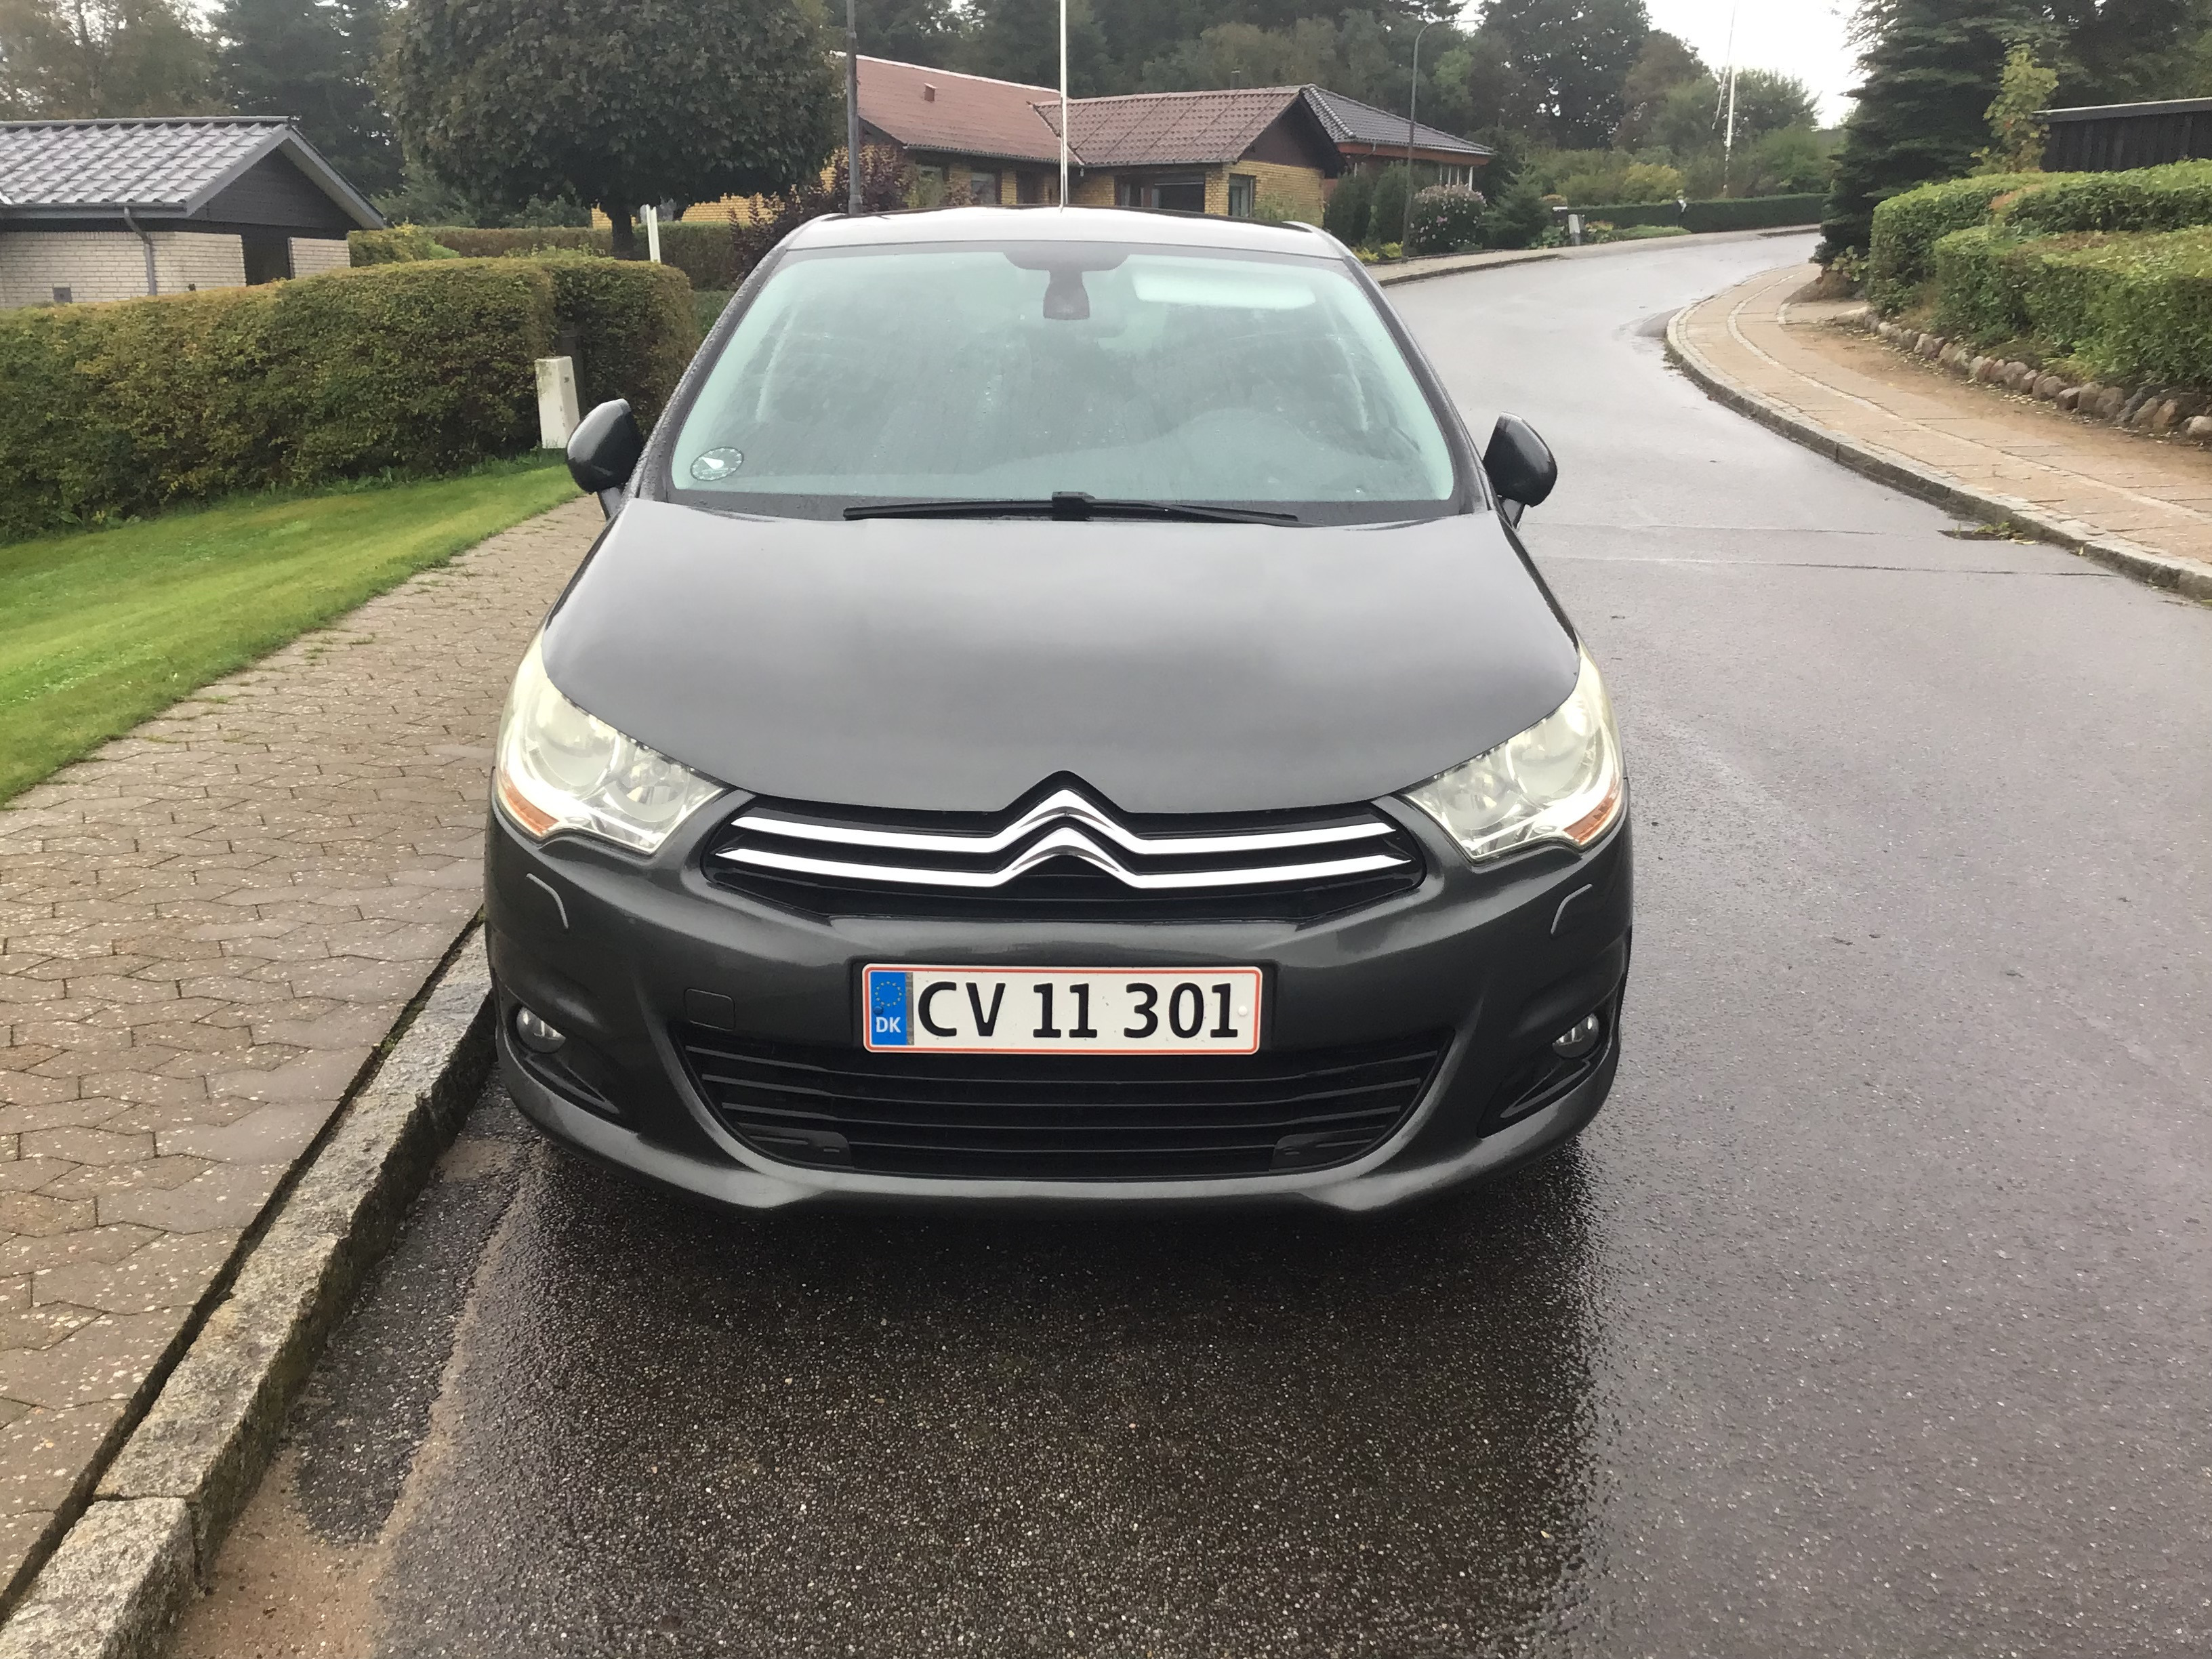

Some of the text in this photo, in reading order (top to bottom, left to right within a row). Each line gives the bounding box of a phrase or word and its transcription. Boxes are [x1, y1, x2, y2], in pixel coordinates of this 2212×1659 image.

[876, 1017, 901, 1033] DK
[918, 981, 1239, 1039] CV 11 301
